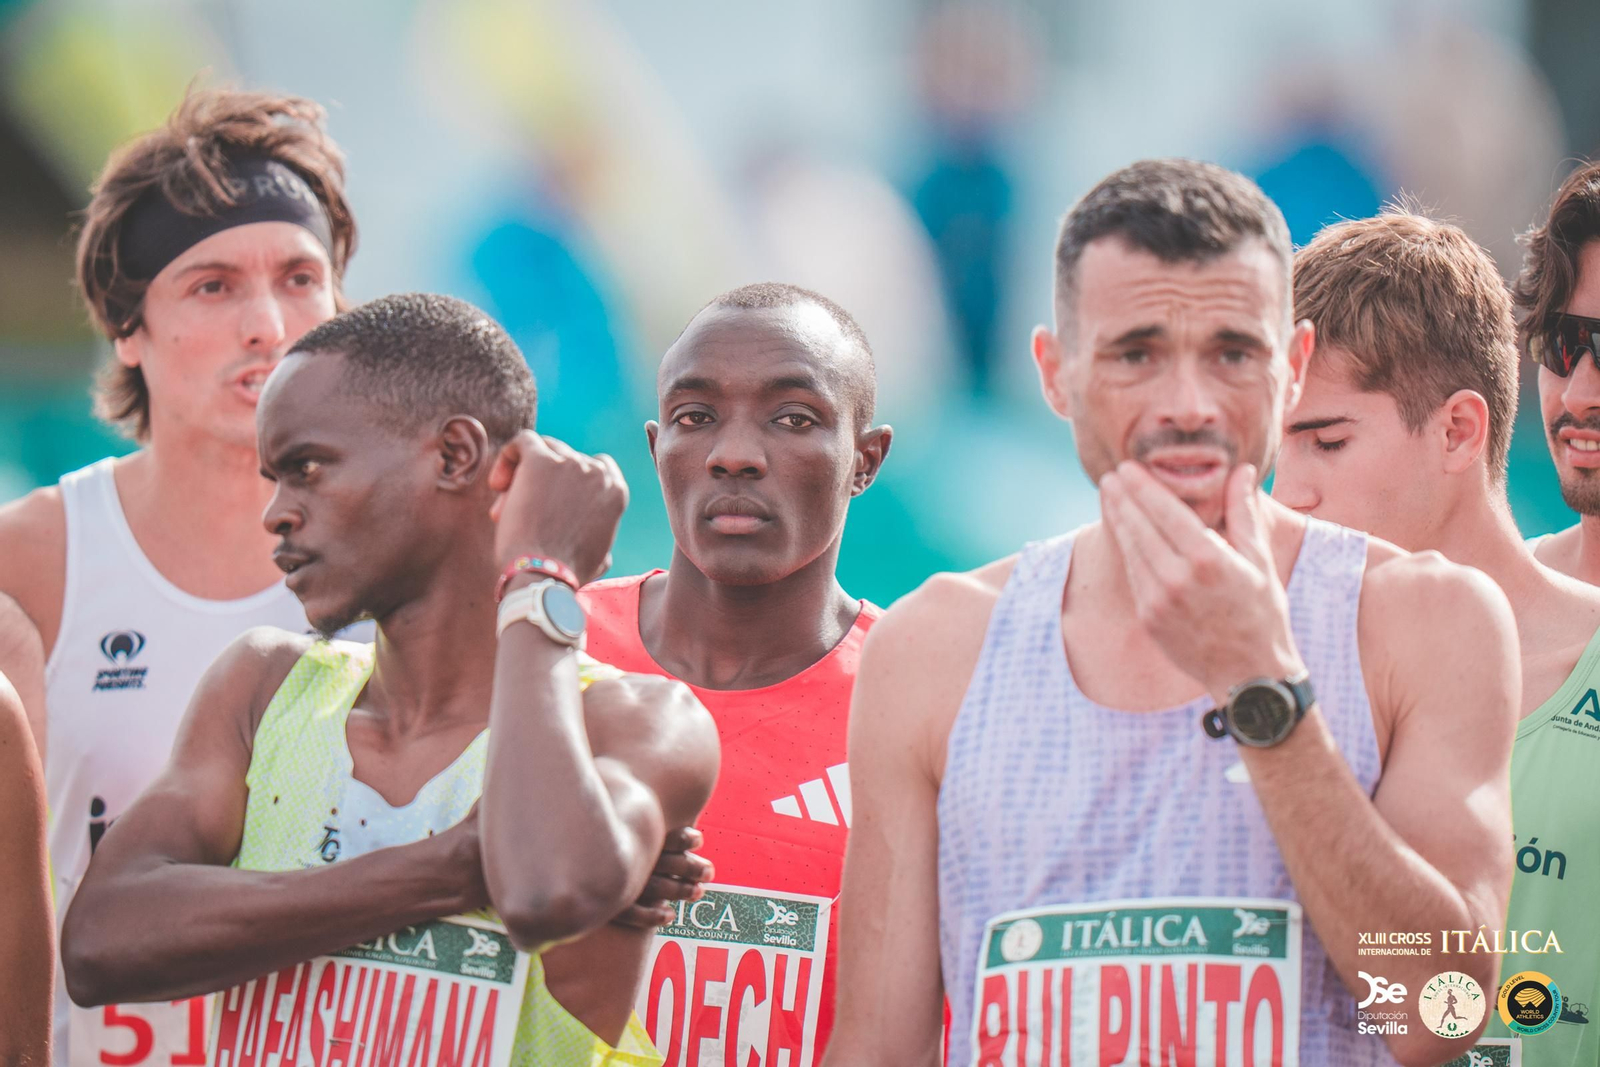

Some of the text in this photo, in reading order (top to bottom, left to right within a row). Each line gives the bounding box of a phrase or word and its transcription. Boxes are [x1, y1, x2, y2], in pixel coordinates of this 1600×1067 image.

[1573, 719, 1583, 727] de
[668, 927, 696, 936] CROSS
[699, 930, 740, 941] COUNTRY
[1061, 911, 1209, 950] ITÁLICA
[763, 933, 797, 946] Sevilla
[1100, 963, 1285, 1067] PINTO
